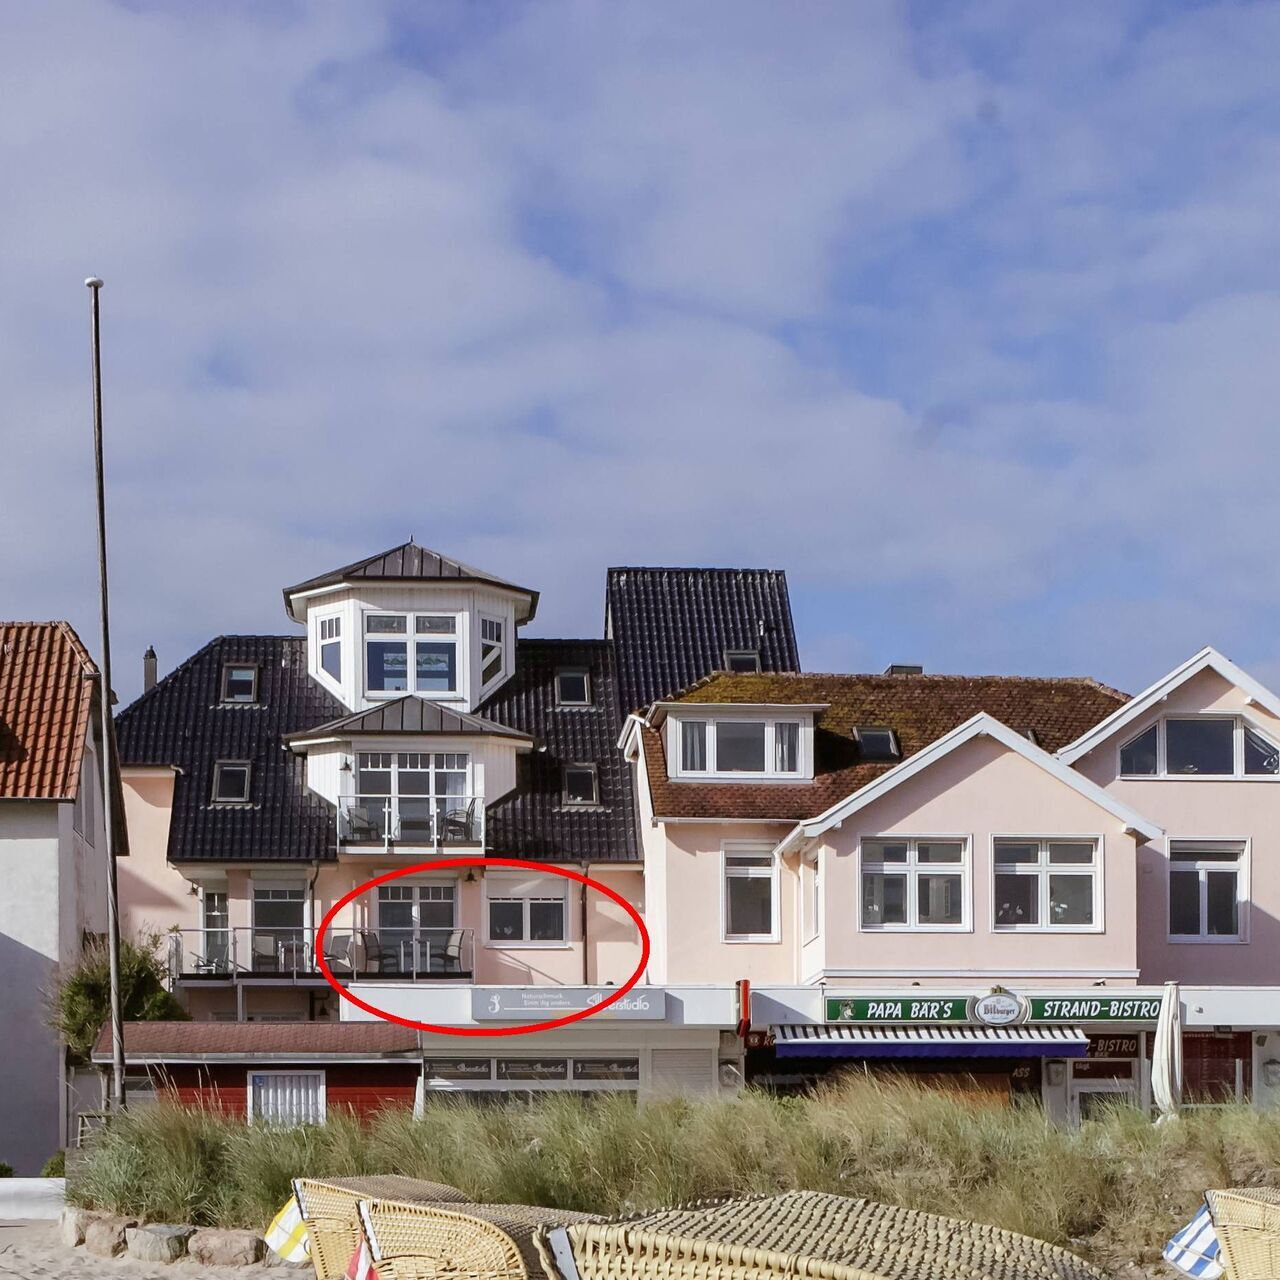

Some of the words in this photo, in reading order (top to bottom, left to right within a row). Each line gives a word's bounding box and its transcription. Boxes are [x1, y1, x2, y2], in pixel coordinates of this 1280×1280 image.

[867, 1002, 902, 1018] PAPA
[911, 1002, 953, 1018] BÄR'S
[1043, 1001, 1160, 1018] STRAND-BISTRO
[1086, 1039, 1136, 1052] -BISTRO
